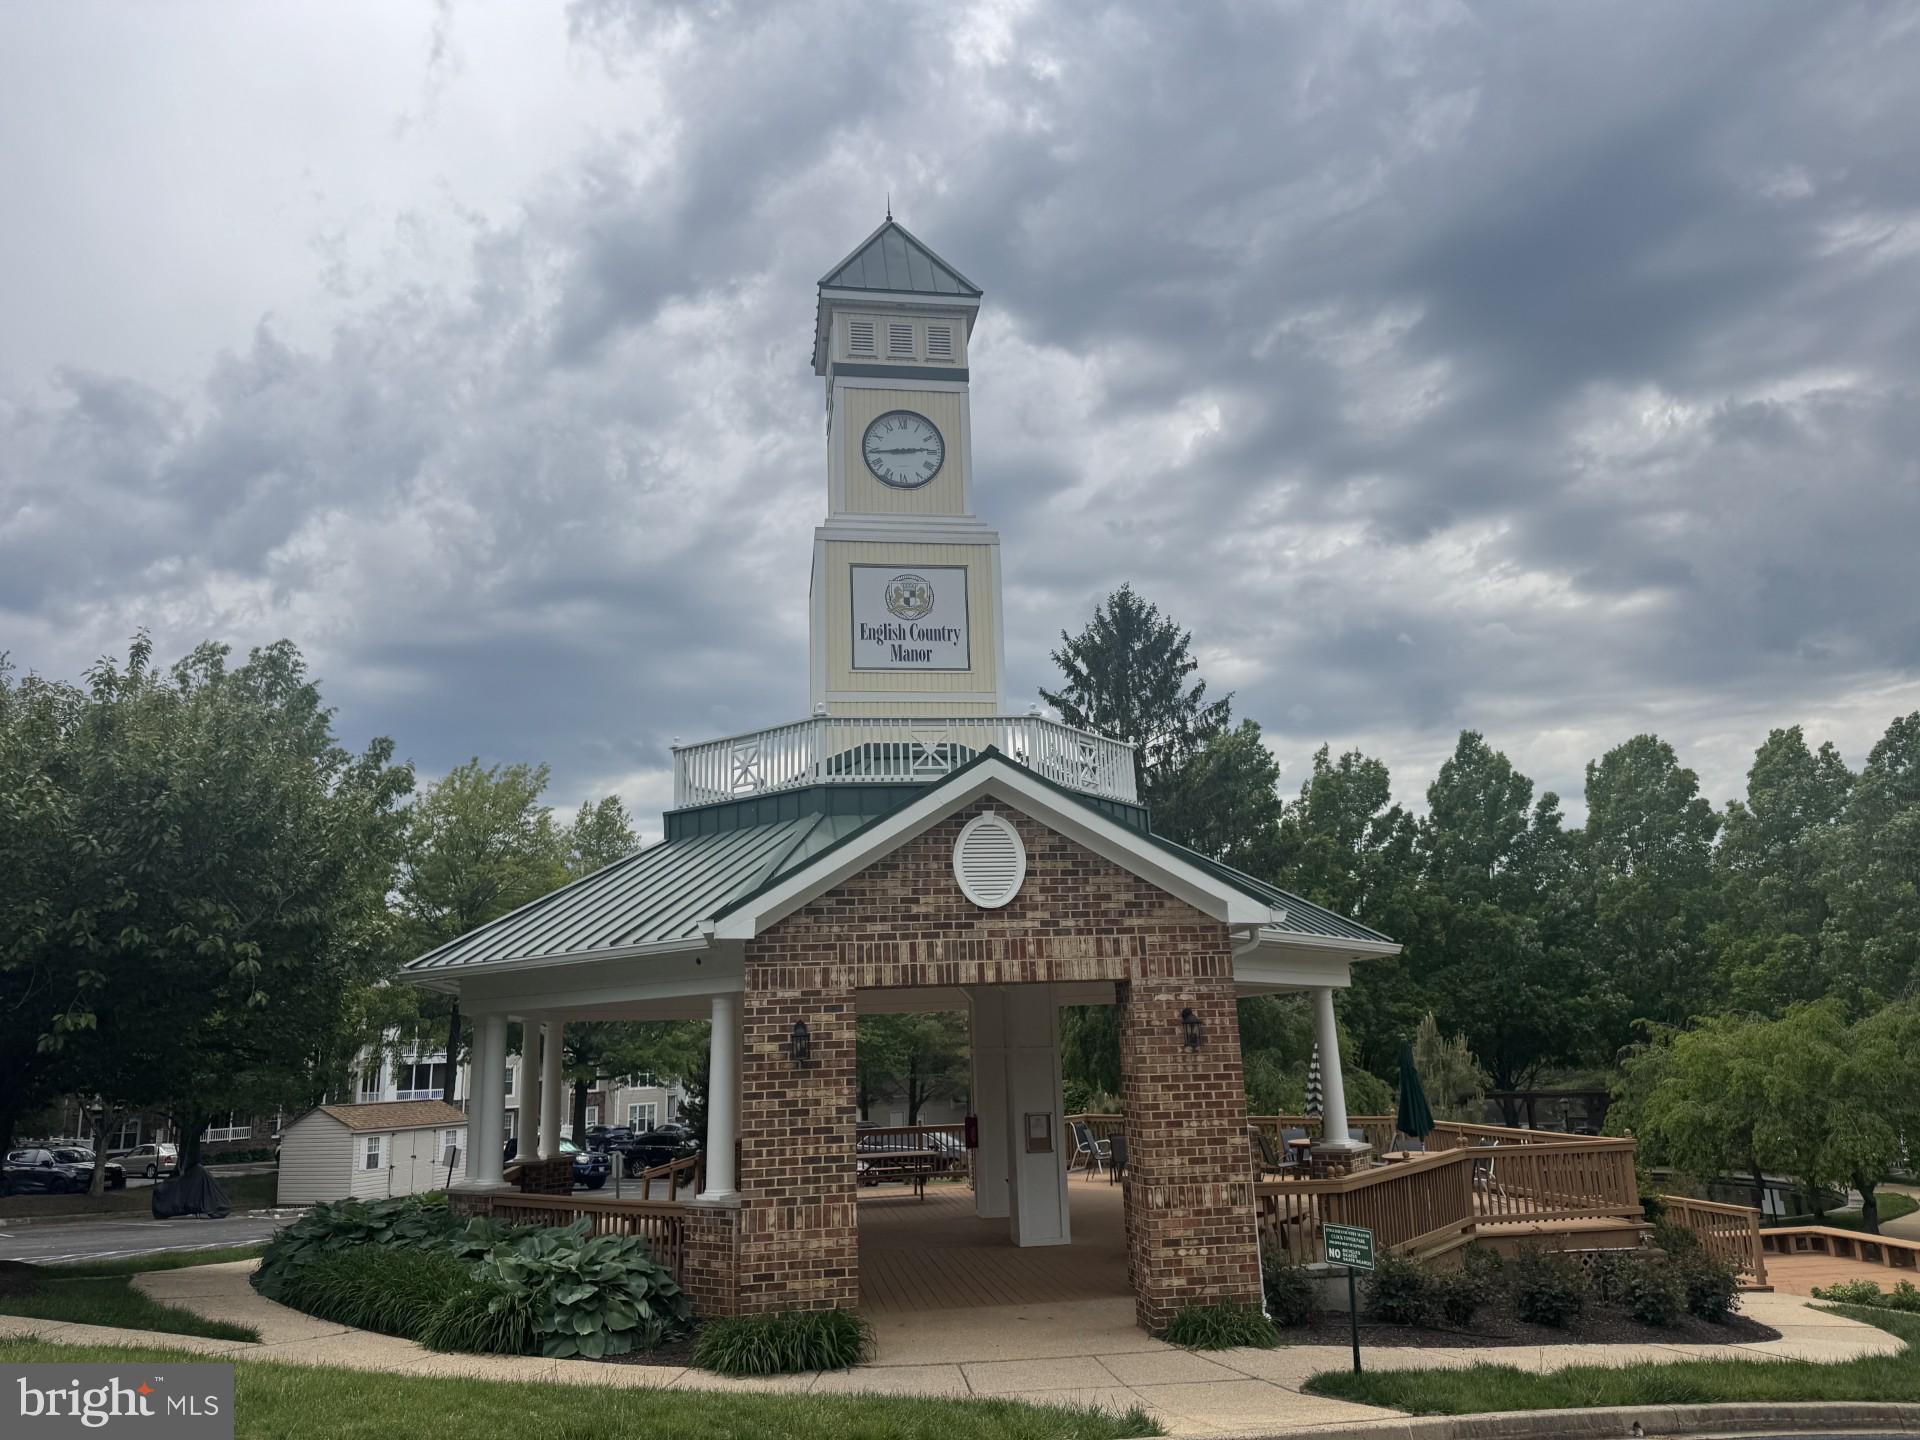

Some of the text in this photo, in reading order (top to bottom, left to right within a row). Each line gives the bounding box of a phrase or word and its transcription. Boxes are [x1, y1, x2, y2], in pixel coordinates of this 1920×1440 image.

[860, 622, 961, 646] English Country
[890, 644, 933, 662] Manor
[1328, 1247, 1341, 1259] NO
